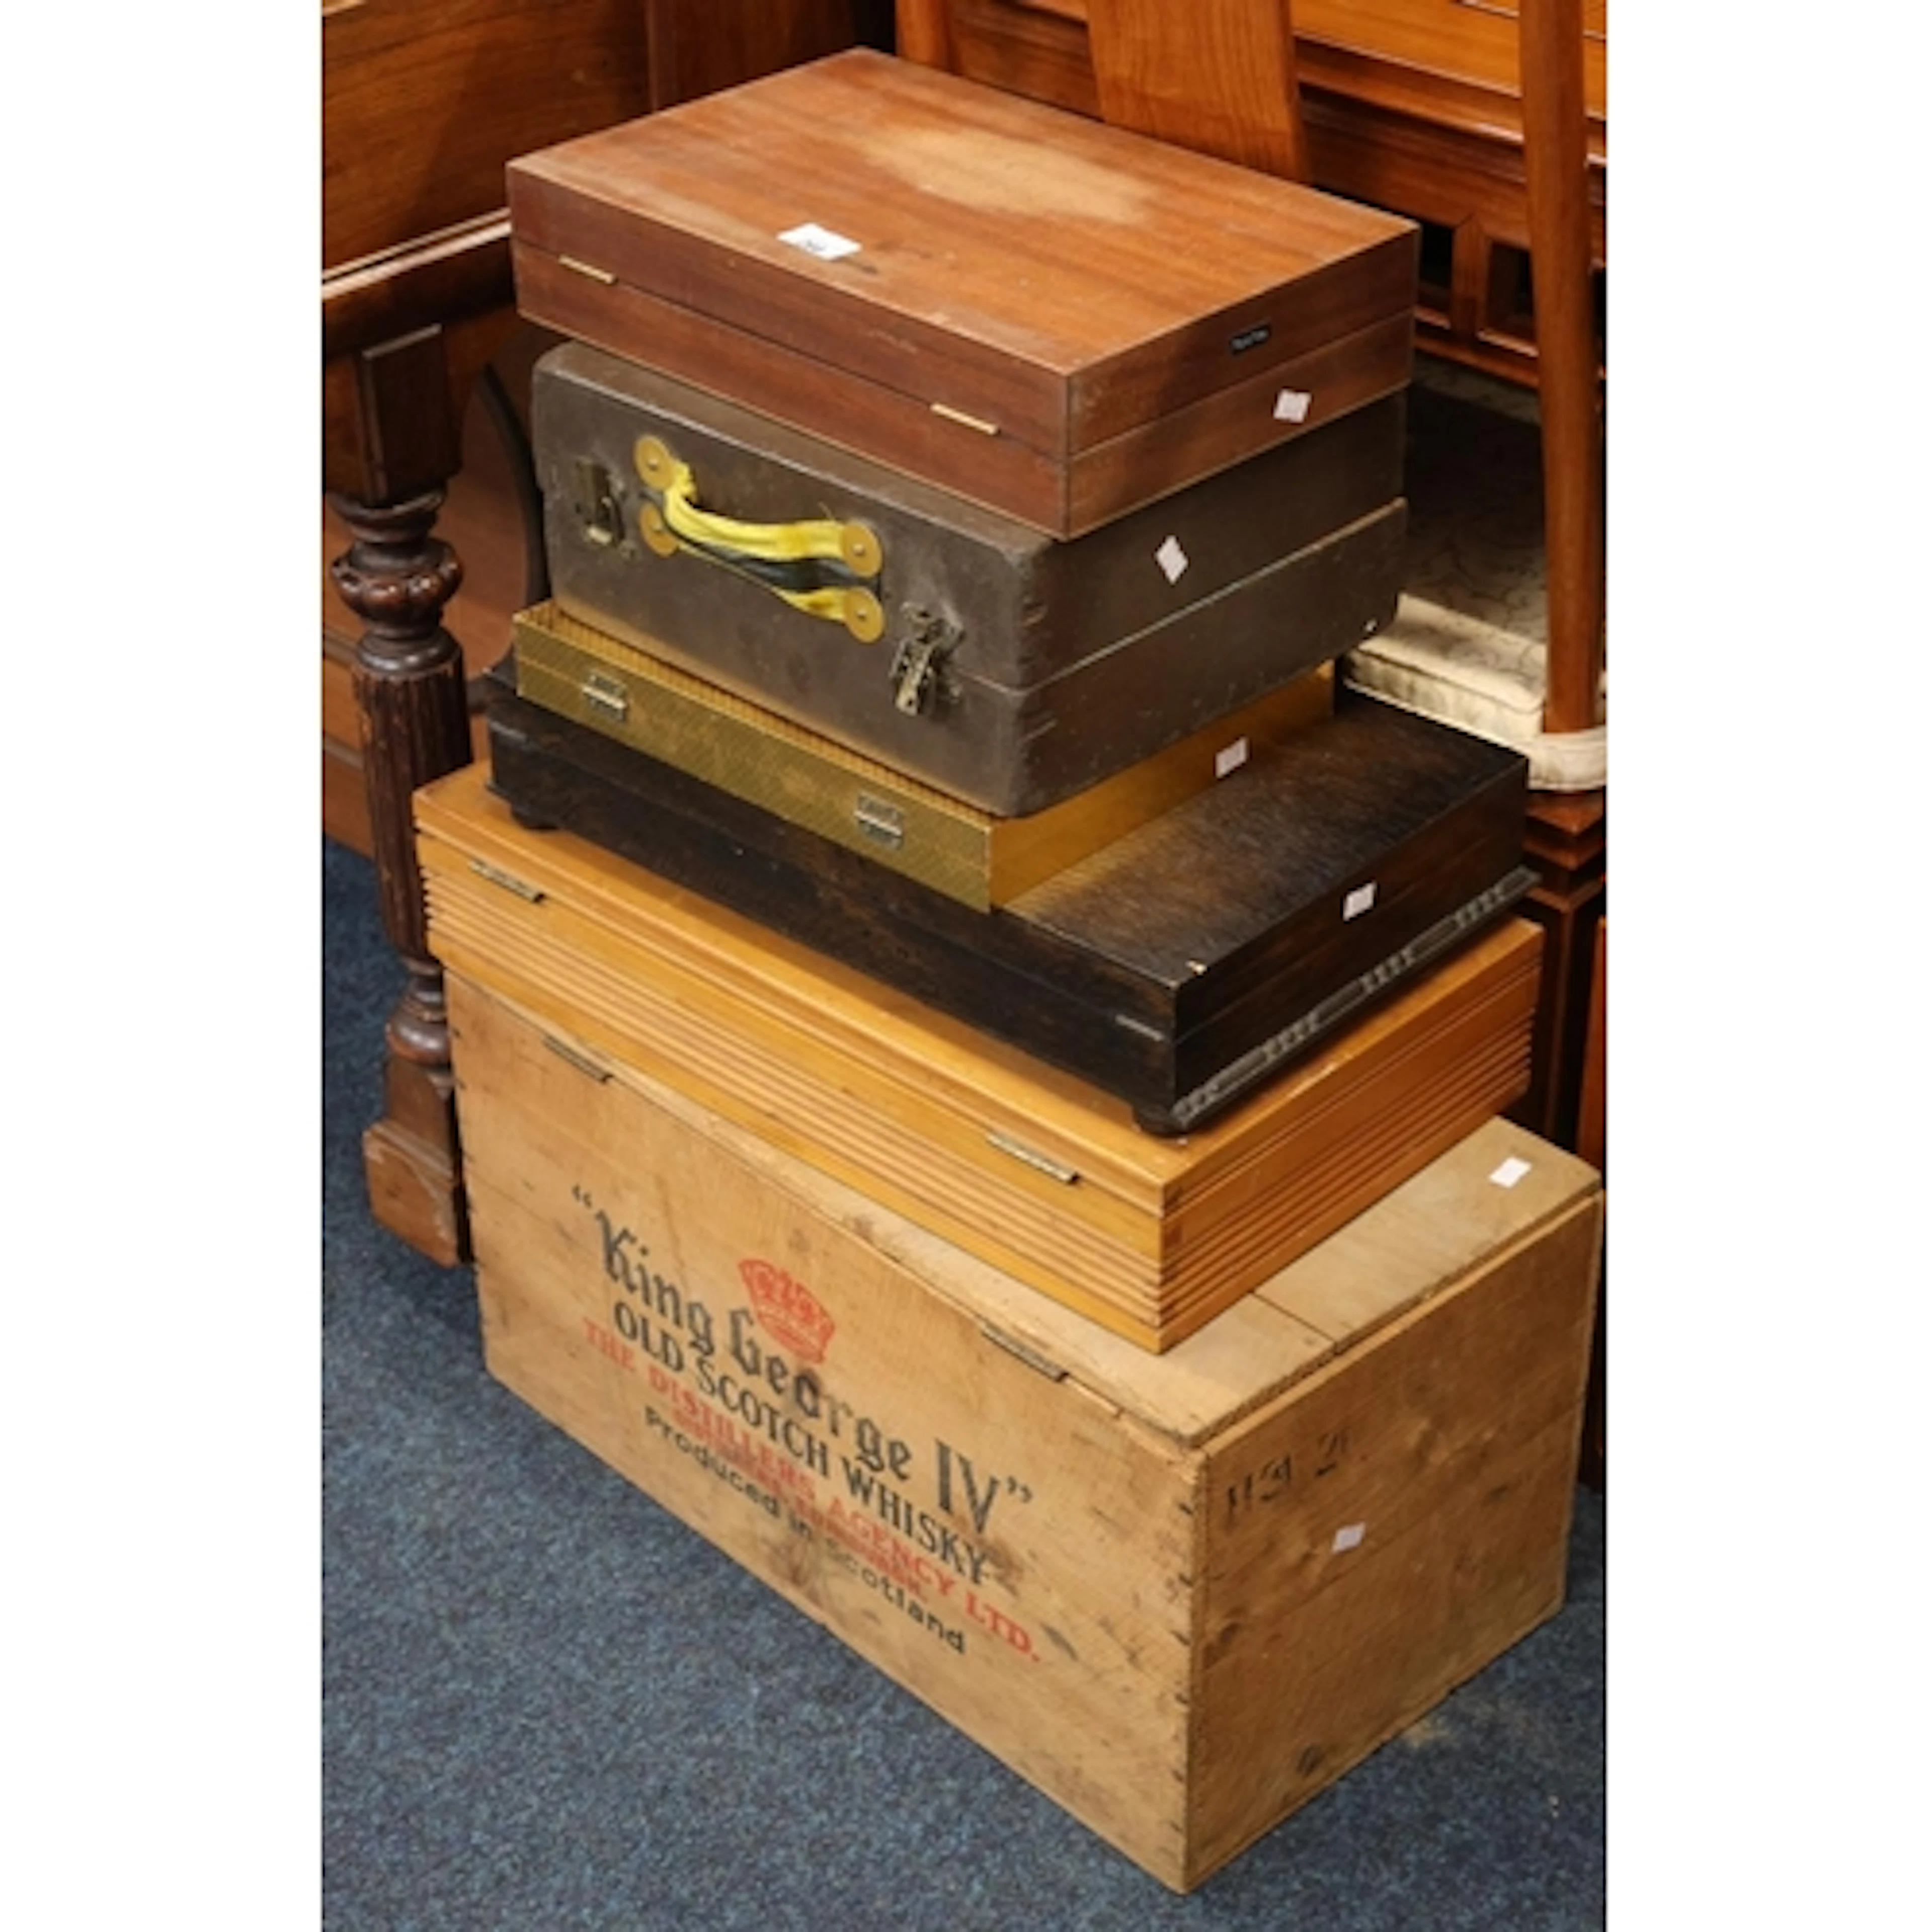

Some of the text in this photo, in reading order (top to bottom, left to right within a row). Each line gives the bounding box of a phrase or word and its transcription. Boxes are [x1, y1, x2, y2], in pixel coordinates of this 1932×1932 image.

[583, 1315, 636, 1374] THE
[827, 1495, 956, 1596] AGENCY
[613, 1300, 684, 1373] OLD
[696, 1355, 830, 1479] SCOTCH
[840, 1455, 990, 1585] WHISKY
[729, 1307, 912, 1481] George
[645, 1405, 780, 1518] Produced
[825, 1538, 967, 1655] Scotland
